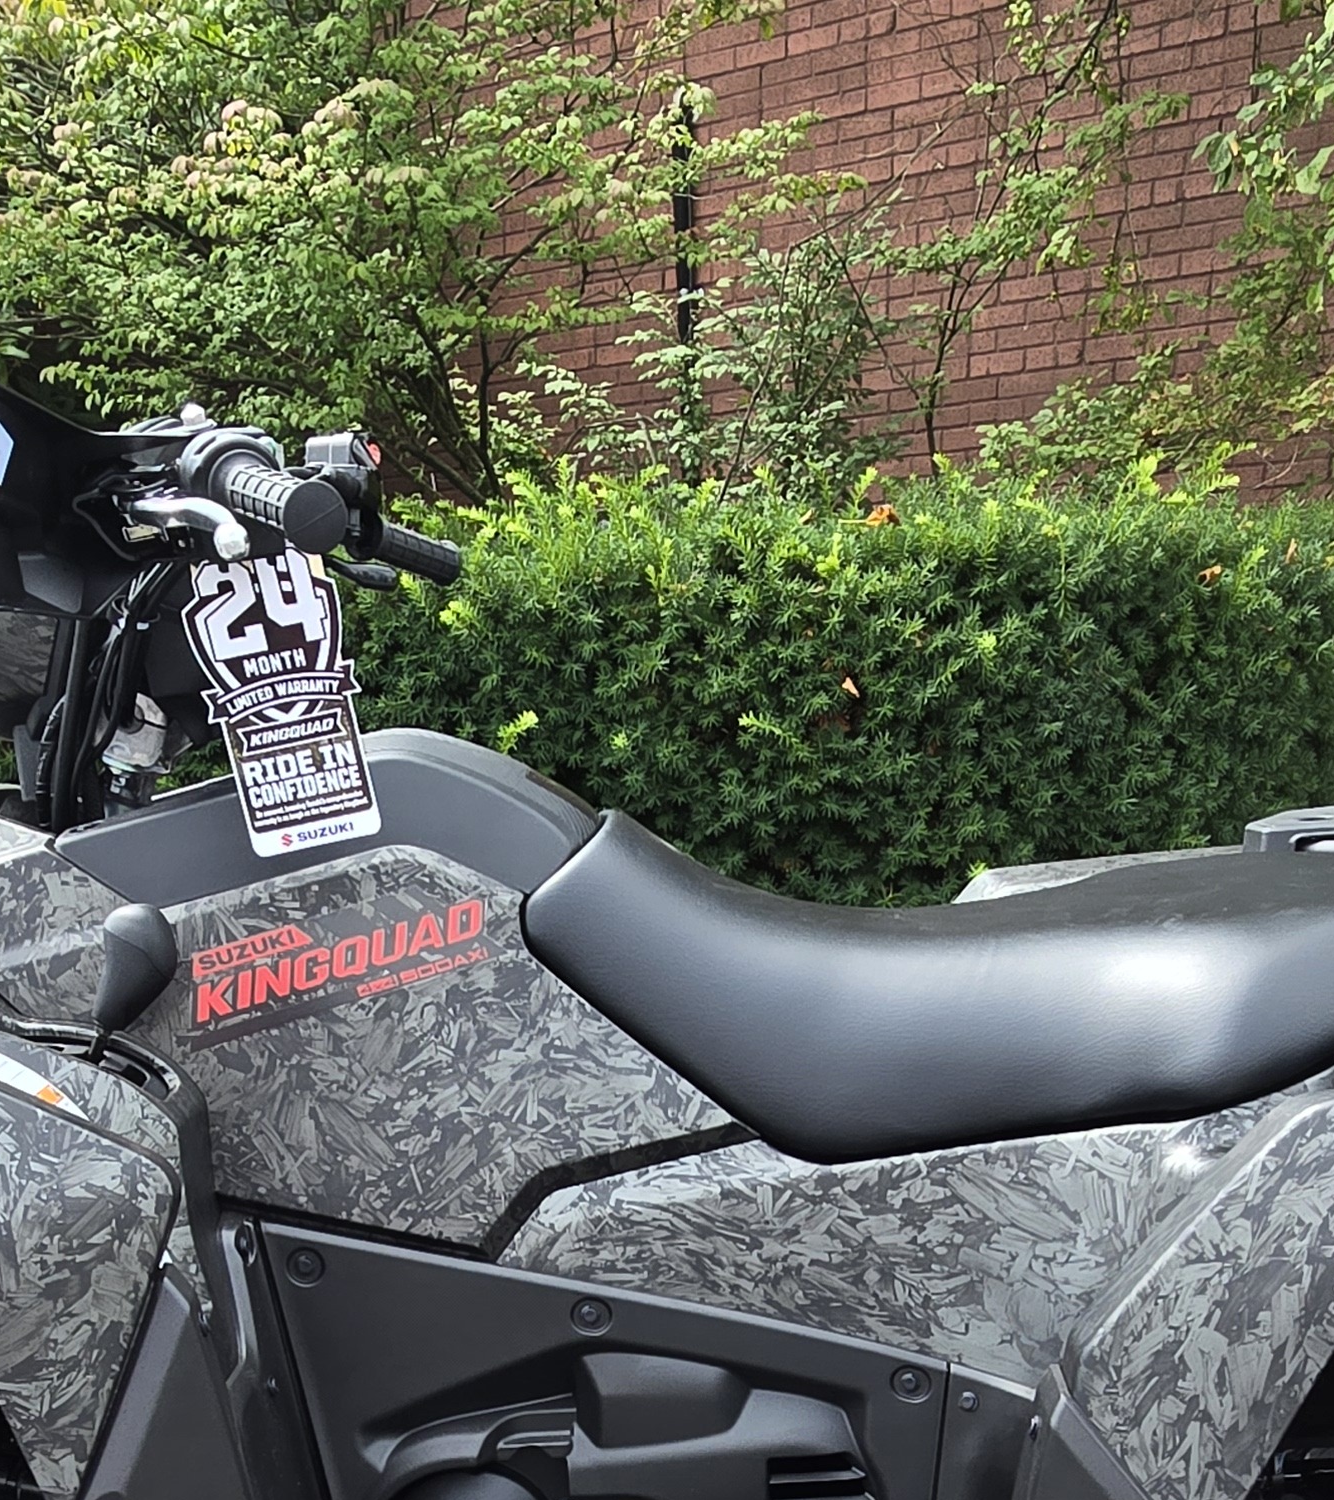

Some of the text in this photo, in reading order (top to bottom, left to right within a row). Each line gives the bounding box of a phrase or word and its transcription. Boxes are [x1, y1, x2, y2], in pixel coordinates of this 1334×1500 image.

[196, 548, 327, 662] 24
[242, 648, 307, 678] MONTH
[226, 679, 340, 715] LIMITED WARRANTY
[250, 718, 334, 747] KINGQUAD
[242, 739, 358, 788] RIDE IN
[248, 768, 362, 809] CONFIDENCE
[297, 822, 354, 842] SUZUKI
[196, 899, 485, 1023] KINGQUAD
[197, 931, 298, 971] SUZUKI
